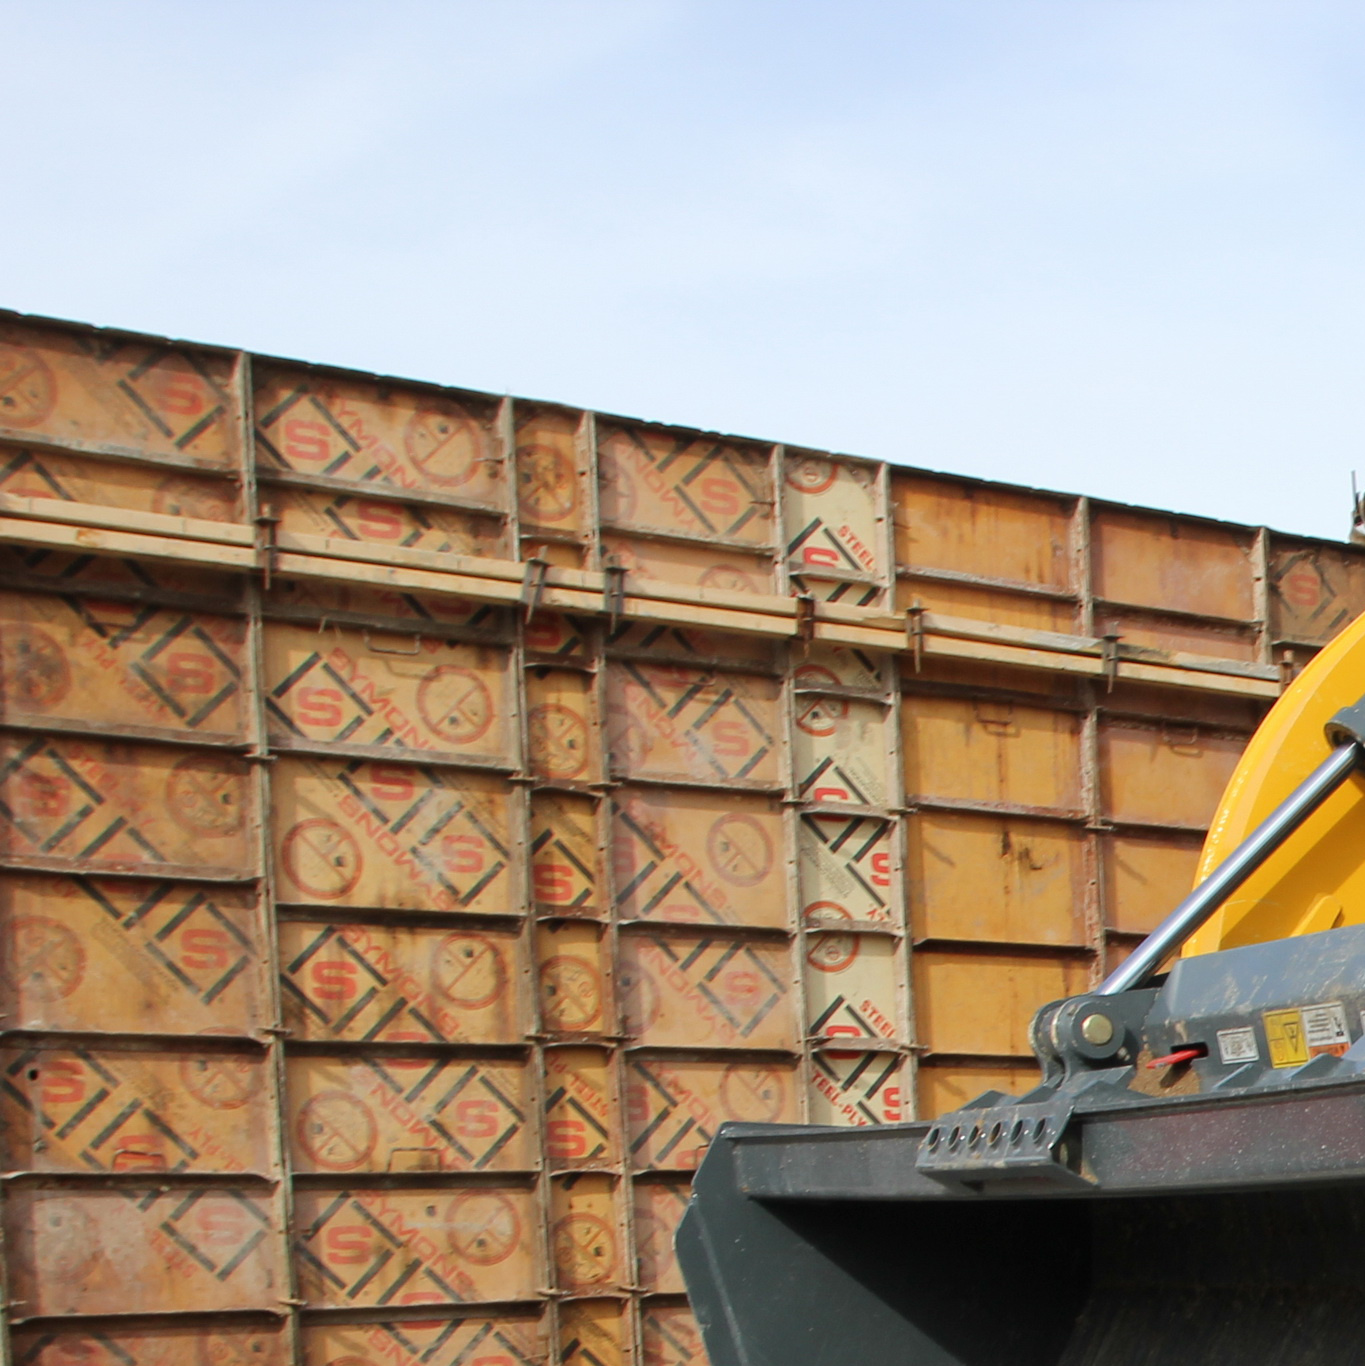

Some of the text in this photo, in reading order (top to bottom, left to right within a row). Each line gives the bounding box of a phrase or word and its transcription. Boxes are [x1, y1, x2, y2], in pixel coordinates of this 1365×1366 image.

[283, 419, 331, 461] S
[701, 477, 741, 516] S
[357, 500, 402, 539] S
[1288, 573, 1322, 606] S
[166, 652, 215, 694] S
[298, 686, 343, 727] S
[327, 646, 438, 751] SYMON
[711, 721, 751, 757] S
[371, 763, 415, 801] S
[338, 793, 451, 908] SYMONS
[440, 834, 485, 873] S
[534, 863, 574, 901] S
[181, 928, 231, 970] S
[311, 961, 357, 1000] S
[342, 924, 460, 1036] SYMONS
[41, 1061, 84, 1103] S
[811, 1067, 868, 1126] TEEL-PLY
[455, 1100, 500, 1138] S
[547, 1120, 588, 1157] S
[326, 1225, 373, 1264] S
